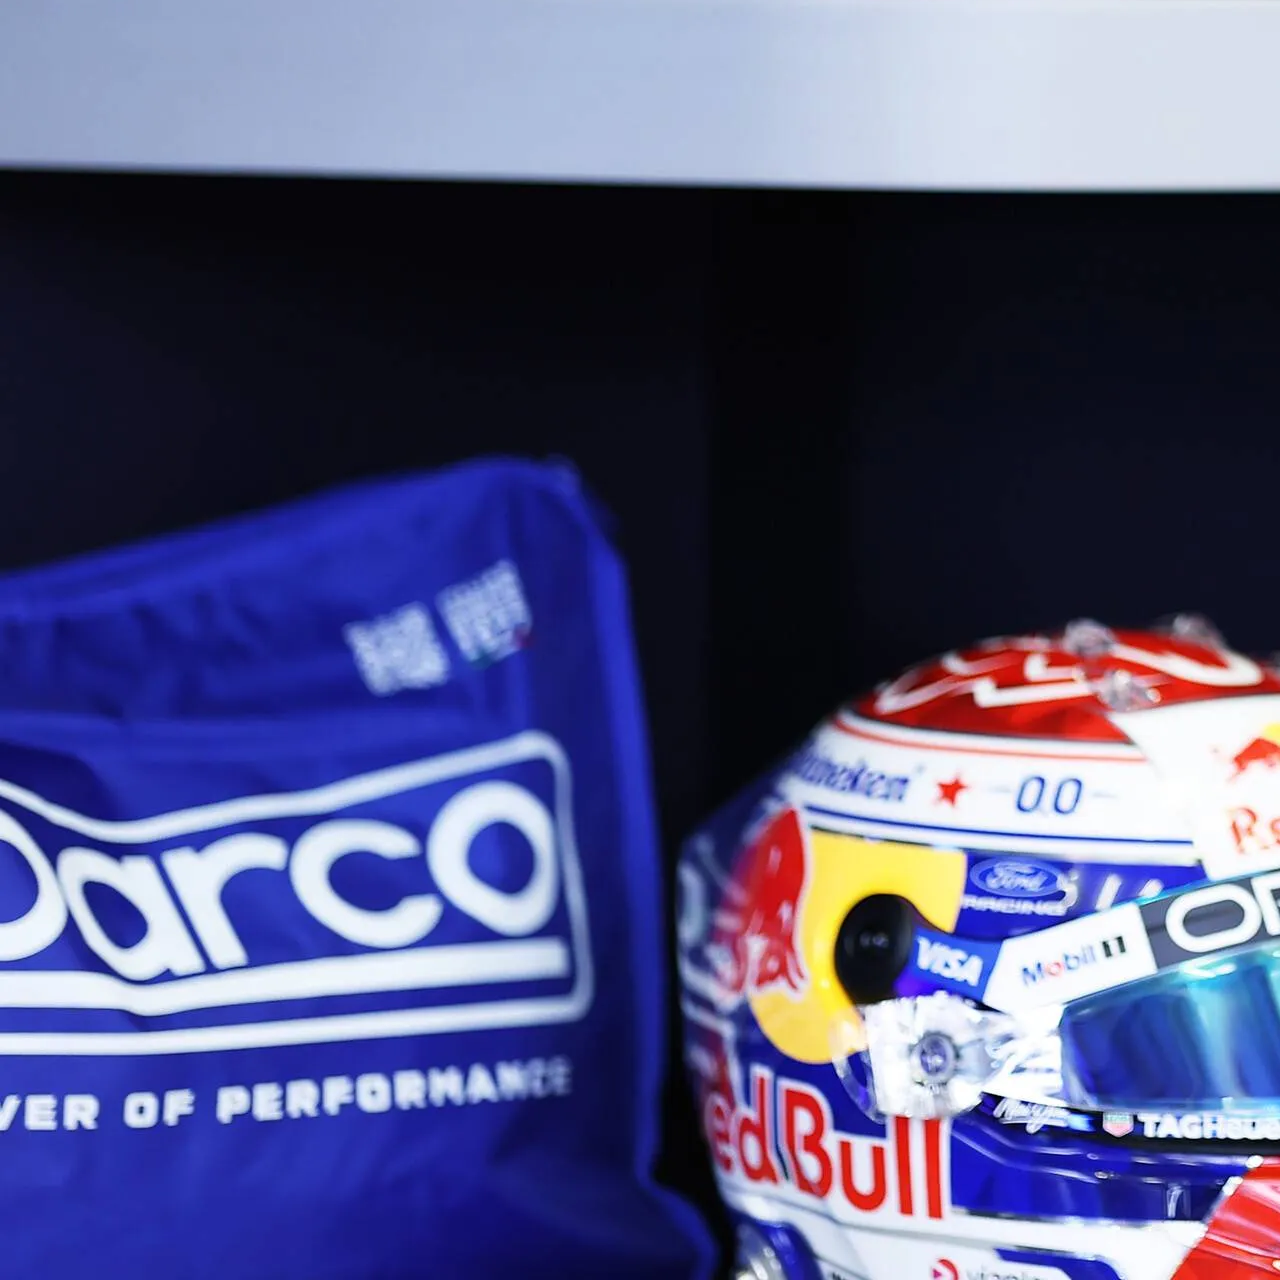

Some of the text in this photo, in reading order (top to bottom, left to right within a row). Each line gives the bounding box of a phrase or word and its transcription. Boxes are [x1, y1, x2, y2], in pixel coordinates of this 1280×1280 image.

[0, 779, 562, 982] arco
[917, 936, 983, 987] VISA
[1021, 945, 1097, 986] Mobil
[123, 1088, 195, 1129] OF
[215, 1055, 572, 1124] PERFORMANCE
[783, 1085, 945, 1219] Bull
